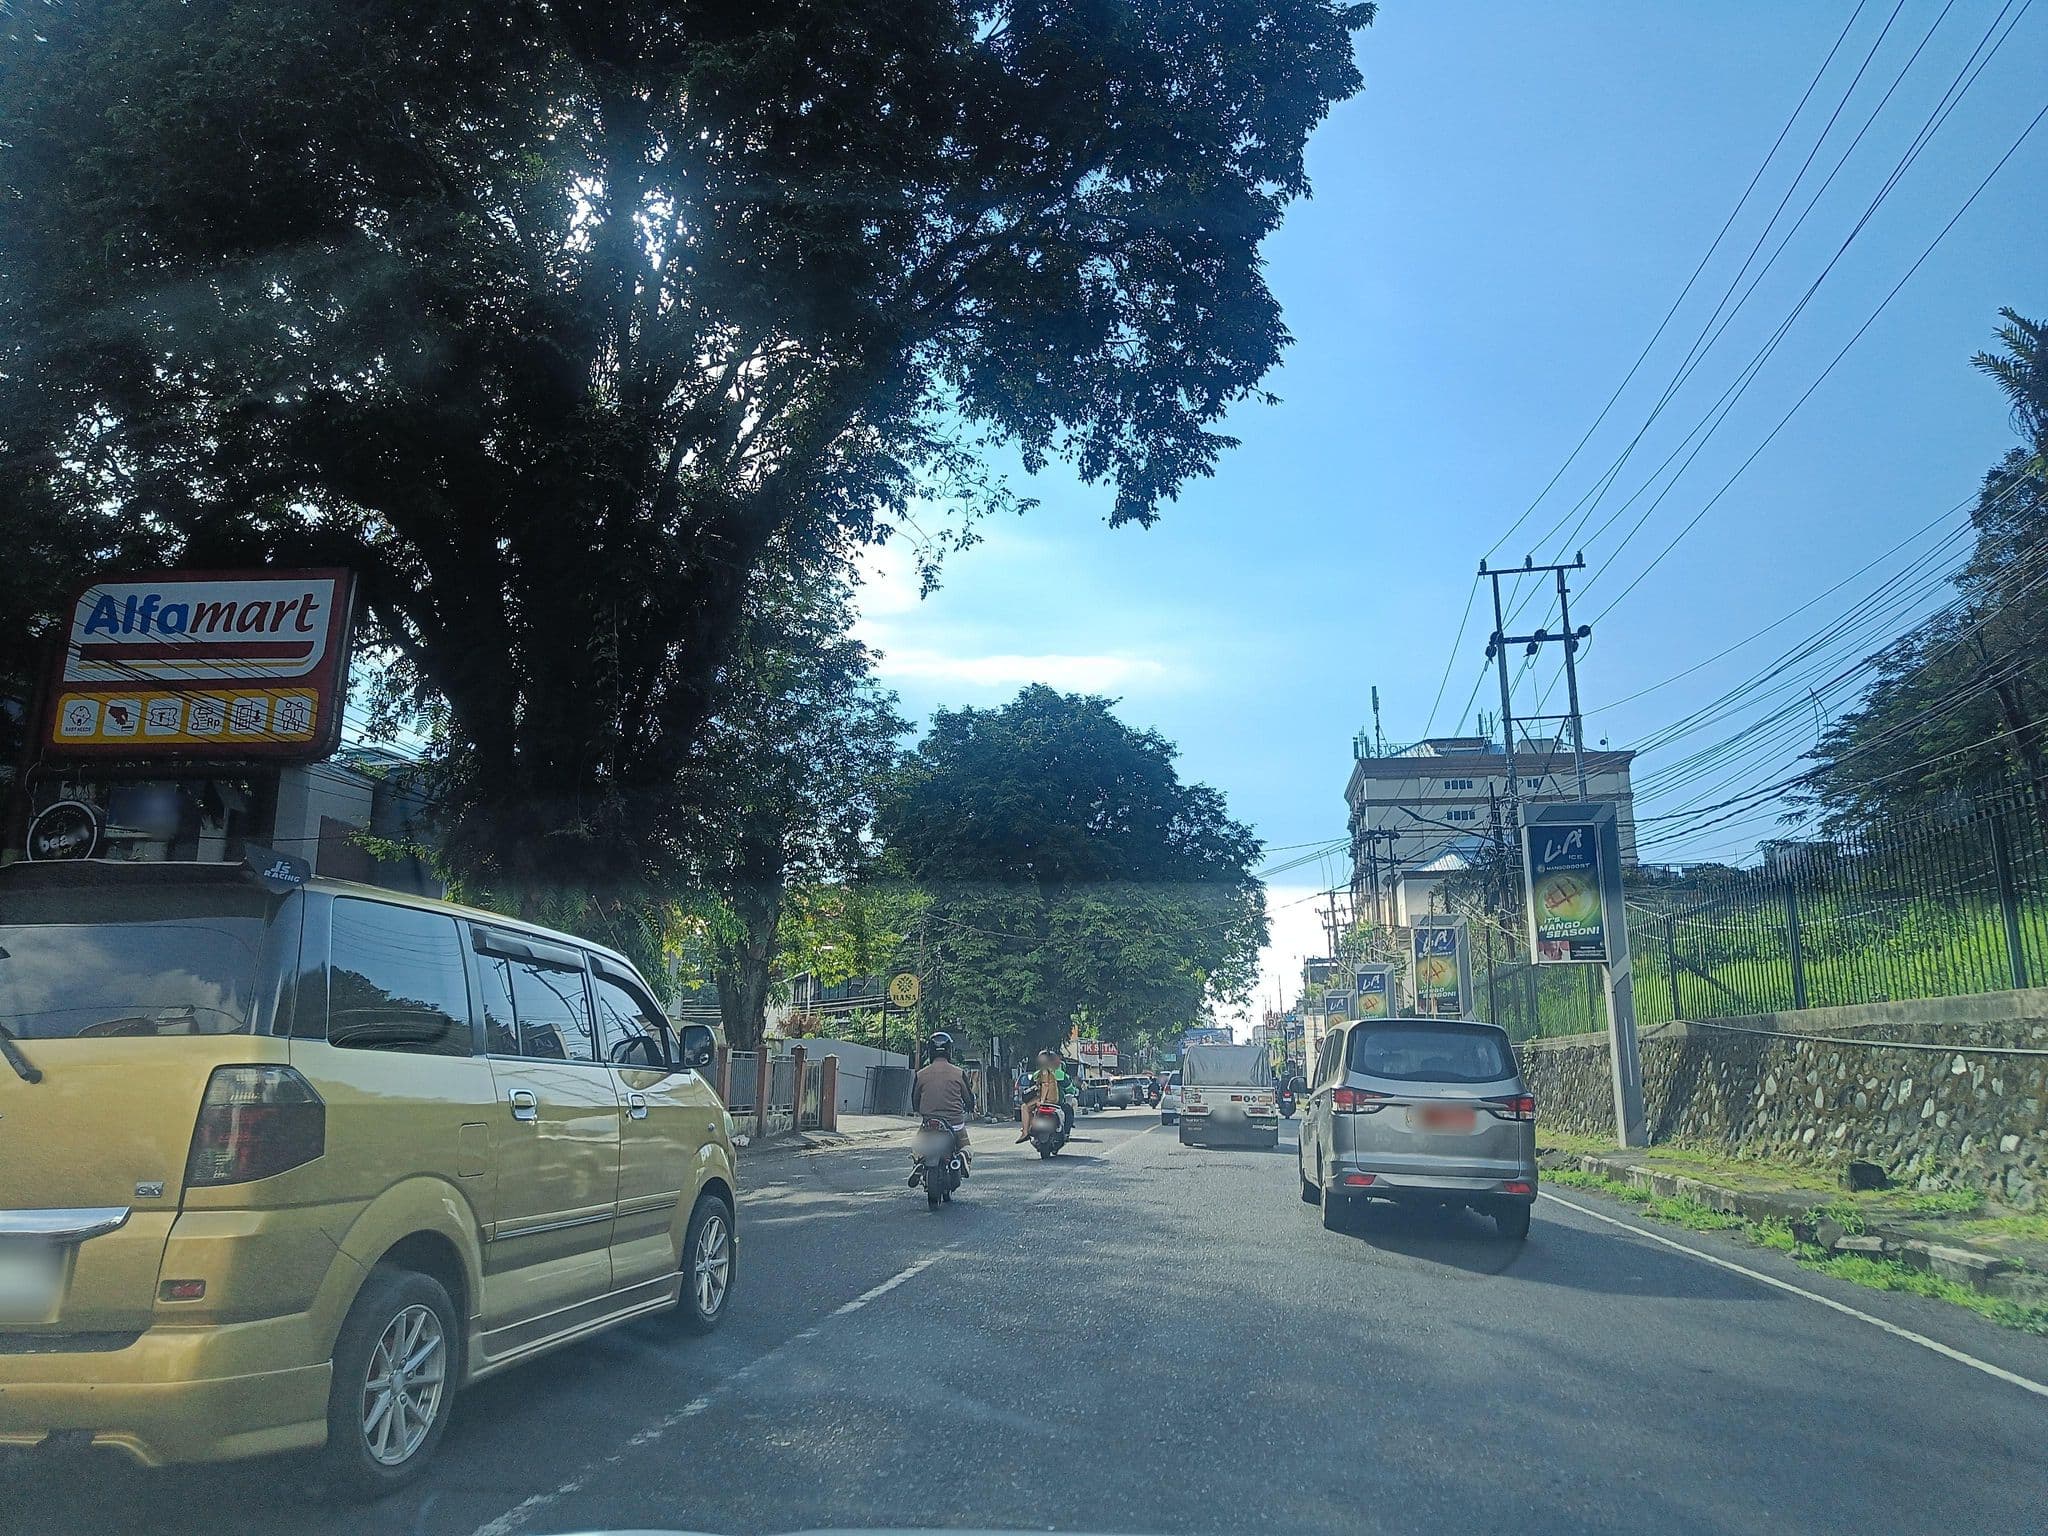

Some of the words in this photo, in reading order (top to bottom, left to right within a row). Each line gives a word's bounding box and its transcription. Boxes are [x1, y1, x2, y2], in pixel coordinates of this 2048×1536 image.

[84, 593, 320, 634] Alfamart
[264, 869, 300, 882] RACING
[1544, 916, 1561, 924] IT'S
[1539, 921, 1580, 932] MANGO
[1546, 926, 1600, 938] SEASON!
